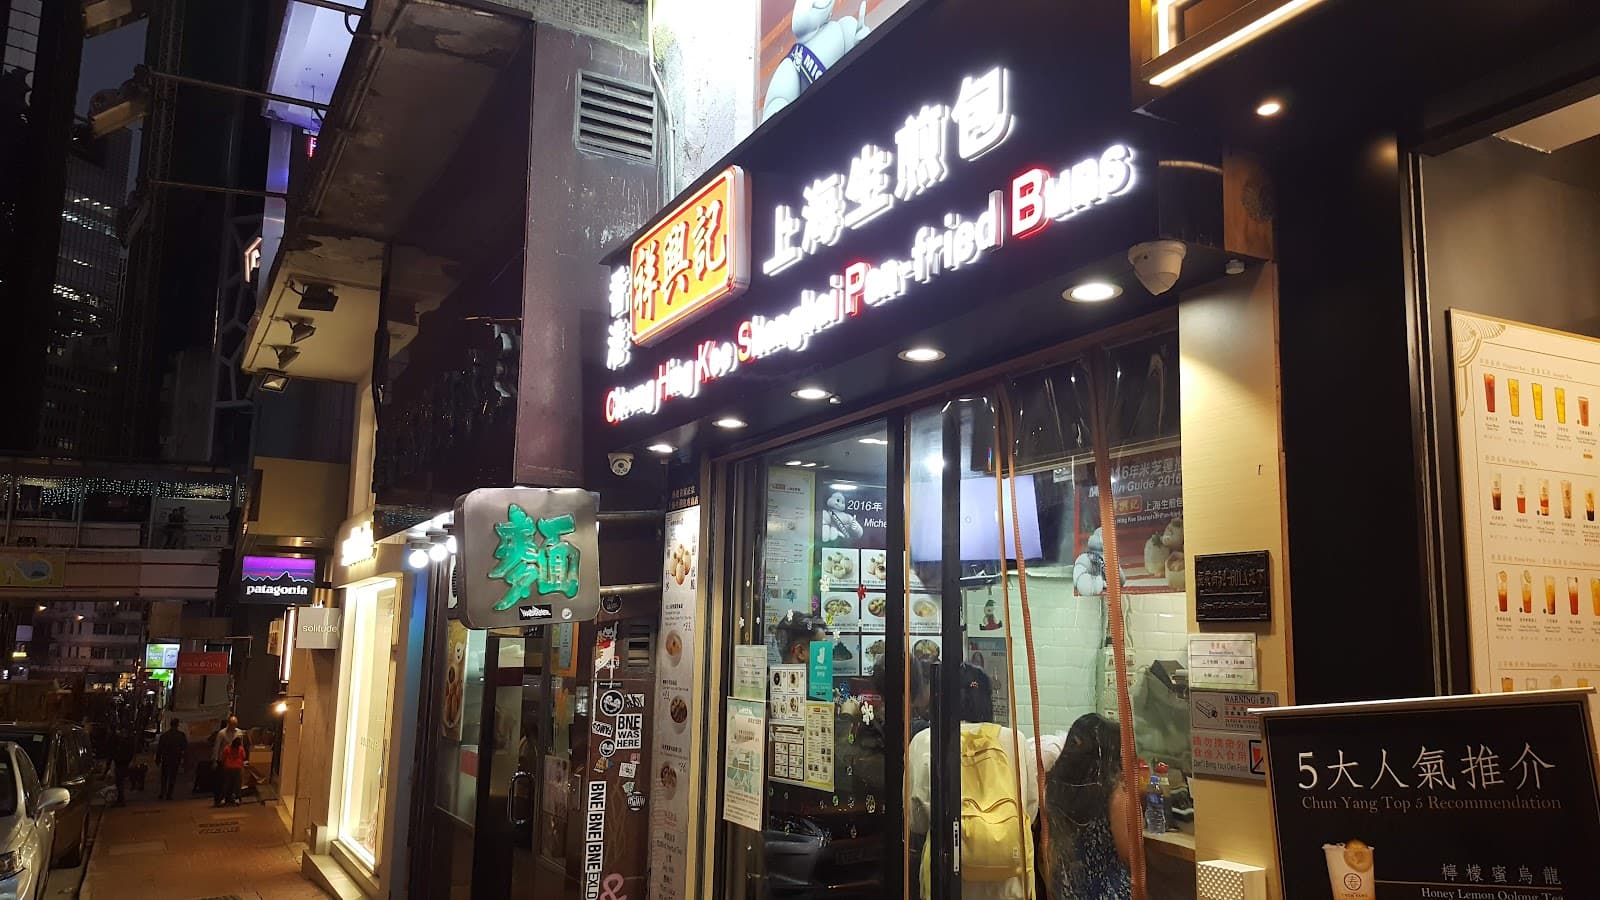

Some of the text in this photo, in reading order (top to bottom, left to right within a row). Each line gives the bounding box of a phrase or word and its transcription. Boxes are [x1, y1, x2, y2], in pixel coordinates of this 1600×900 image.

[763, 65, 1015, 276] 上海生煎包
[635, 200, 727, 321] 祥興記
[697, 340, 739, 383] Kee
[737, 275, 844, 363] Shanghai
[844, 190, 1004, 316] Pan-fried
[1010, 143, 1138, 239] Buns
[1127, 479, 1155, 492] Guide
[1157, 472, 1181, 488] 2016
[847, 499, 884, 512] 2016年
[246, 584, 308, 597] patagonia
[302, 623, 338, 633] solitude
[618, 715, 641, 730] BNE
[616, 739, 640, 748] HERE
[617, 730, 640, 739] WAS
[1298, 742, 1556, 791] 5大人氣推介
[590, 783, 604, 809] BNE
[1302, 795, 1562, 814] Chun Yang Top 5 Recommendation
[588, 813, 602, 840] BNE
[586, 844, 601, 871] BNE
[1440, 863, 1562, 886] 檸檬蜜烏龍
[1421, 887, 1455, 900] Honey
[1457, 888, 1494, 900] Lemon
